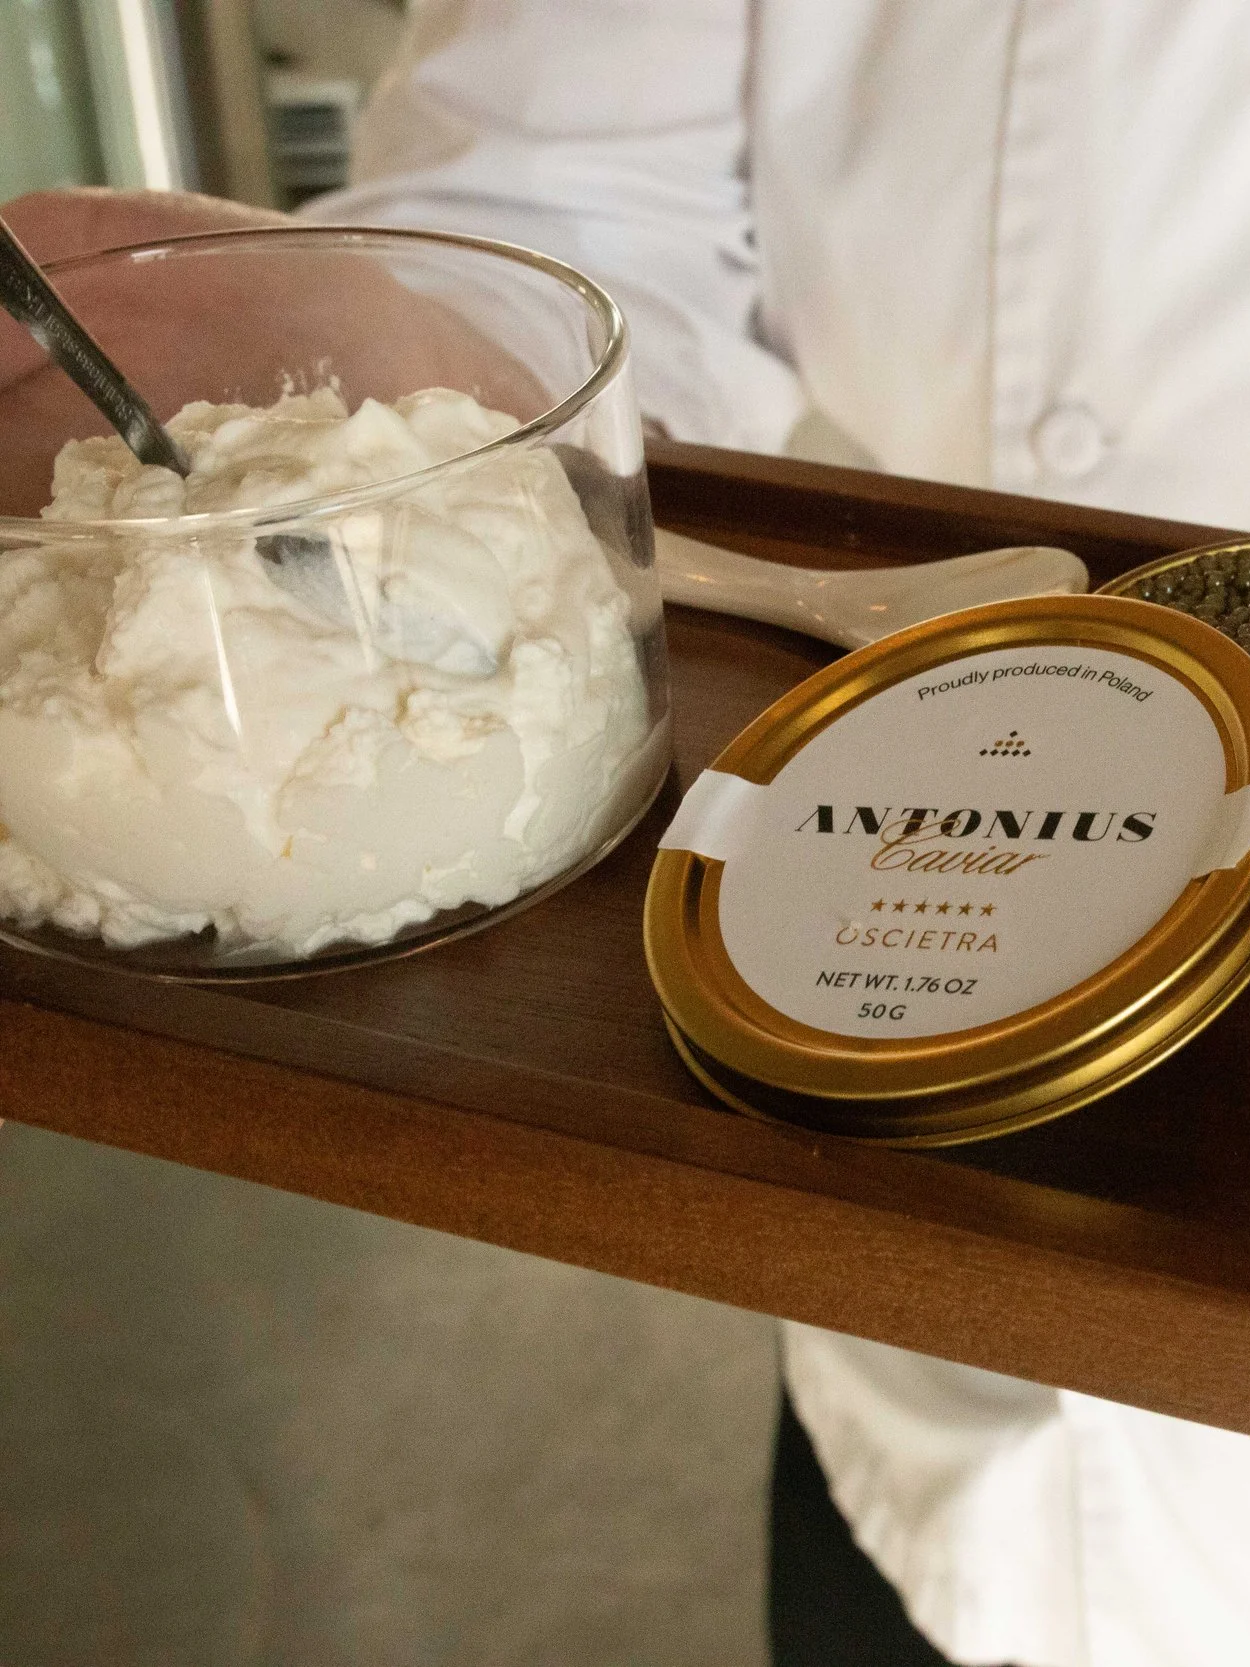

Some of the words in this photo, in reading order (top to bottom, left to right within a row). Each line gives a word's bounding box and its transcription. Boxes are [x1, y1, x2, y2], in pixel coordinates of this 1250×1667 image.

[917, 670, 989, 700] Proudly
[992, 662, 1082, 682] produced
[1080, 665, 1099, 681] in
[1098, 669, 1154, 703] Poland
[794, 804, 1157, 844] ANTONIUS
[870, 818, 1051, 876] Caviar
[836, 926, 999, 953] OSCIETRA
[815, 970, 862, 988] NET
[864, 973, 899, 991] WT.
[903, 976, 941, 994] 1.76
[944, 978, 978, 995] OZ
